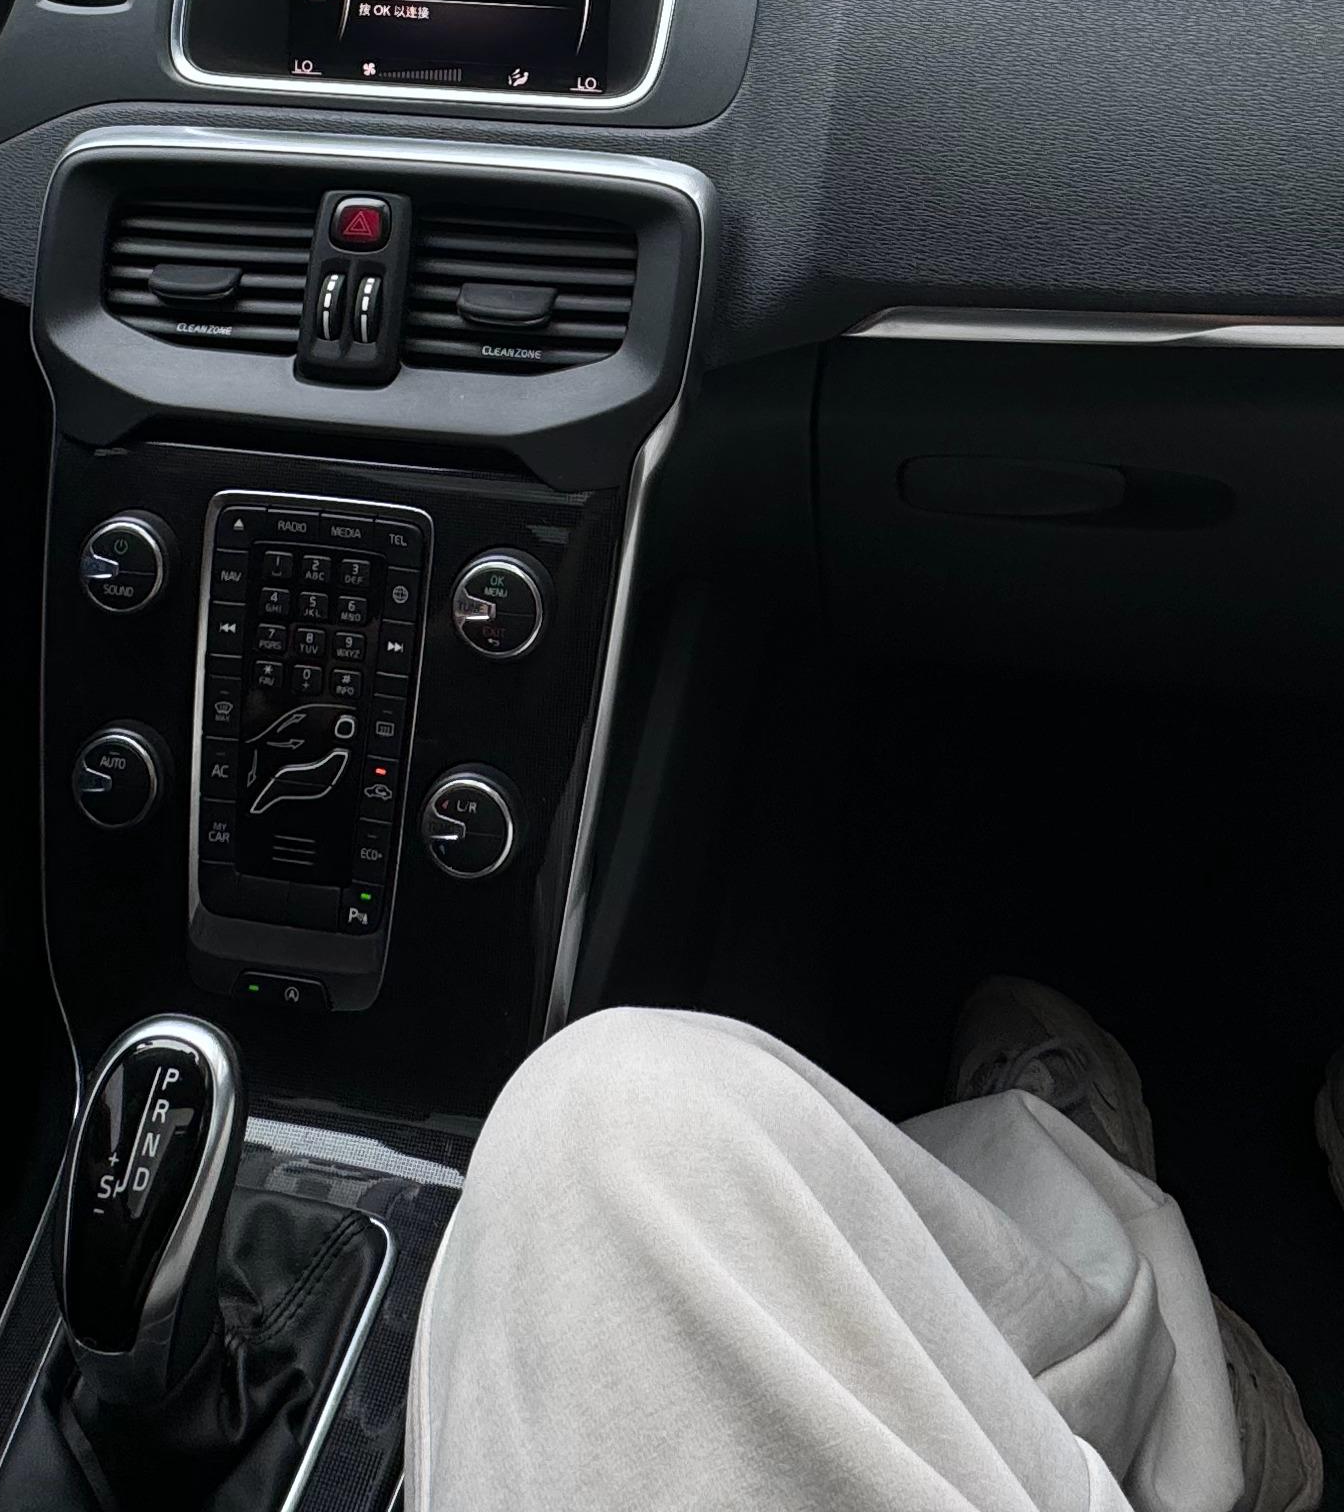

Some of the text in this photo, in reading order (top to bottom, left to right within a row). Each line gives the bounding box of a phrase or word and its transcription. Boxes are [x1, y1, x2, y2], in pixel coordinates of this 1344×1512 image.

[373, 5, 391, 17] OK
[393, 5, 430, 19] 以连接
[295, 60, 313, 73] LO
[577, 76, 597, 90] LO
[277, 520, 306, 533] RADIO
[331, 525, 362, 540] MEDIA
[312, 560, 319, 571] 2
[352, 564, 359, 575] 3
[220, 570, 241, 583] NAV
[305, 571, 325, 581] ABC
[344, 575, 364, 585] DEF
[490, 575, 505, 587] OK
[103, 583, 135, 598] SOUND
[270, 592, 278, 603] 4
[309, 596, 317, 607] 5
[348, 600, 356, 611] 6
[267, 628, 276, 639] 7
[306, 632, 314, 644] 8
[345, 637, 353, 648] 9
[259, 675, 275, 686] FAV
[100, 755, 126, 770] AUTO
[211, 764, 229, 778] AC
[456, 799, 477, 815] L/R
[208, 831, 230, 844] CAR
[162, 1068, 180, 1091] P
[151, 1099, 170, 1124] R
[141, 1132, 159, 1158] N
[132, 1167, 151, 1192] D
[97, 1176, 114, 1199] S
